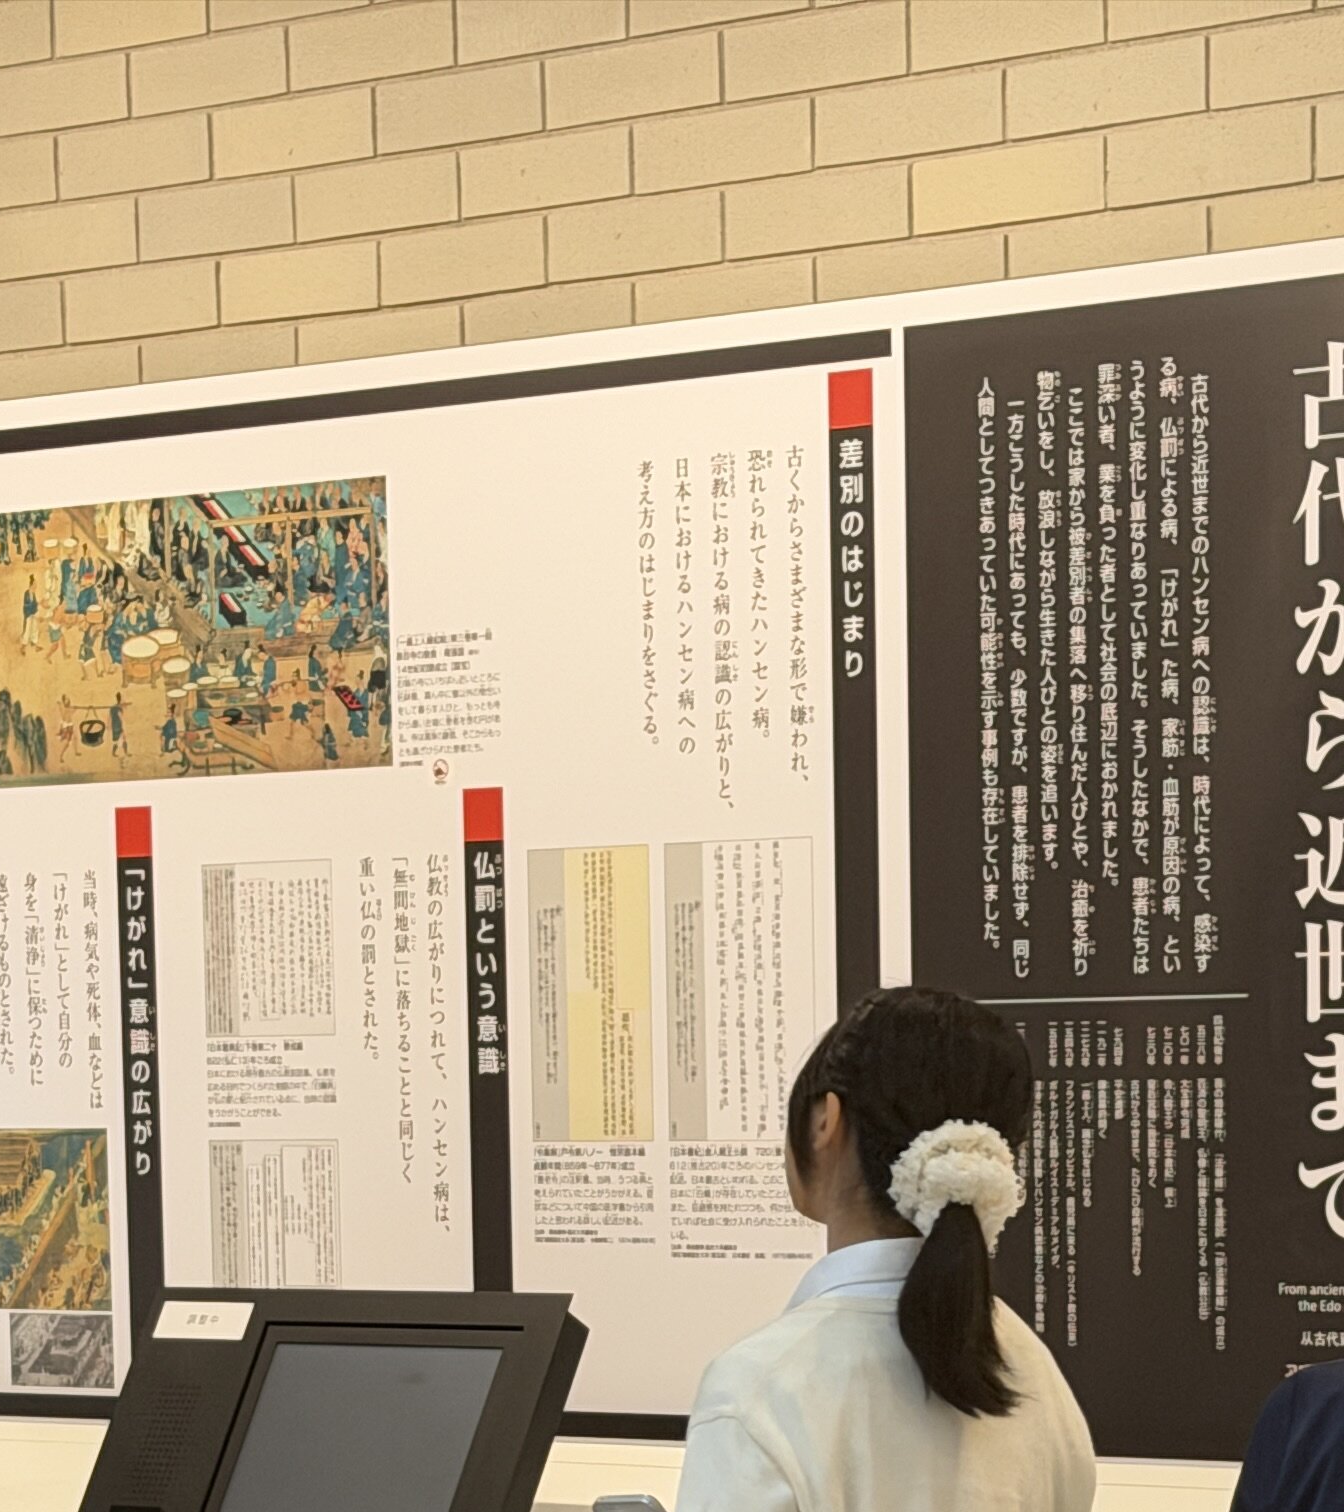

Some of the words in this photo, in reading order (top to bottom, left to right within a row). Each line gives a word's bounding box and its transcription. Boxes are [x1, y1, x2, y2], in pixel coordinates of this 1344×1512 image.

[637, 460, 660, 746] 考え方のはじまりをさぐる。
[674, 457, 697, 756] 日本におけるハンセン病への
[709, 452, 735, 809] 宗教における病の認識の広がりと、
[747, 448, 771, 739] 恐れられてきたハンセン病。
[785, 444, 810, 782] 古くからさまざまな形で嫌われ、
[839, 438, 865, 679] 差別のはじまり
[977, 377, 1001, 949] 人間としてつきあっていた可能性を示す事例も存在していました。
[1007, 401, 1031, 978] 一方こうした時代にあっても、少数ですが、患者を排除せず、同じ
[1036, 371, 1059, 870] 物乞いをし、放浪しながら生きた人びとの姿を追います。
[1129, 360, 1151, 975] うように変化し重なりあっていました。そうしたなかで、患者たちは
[1190, 372, 1213, 974] 古代から近世までのハンセン病への認識は、時代によって、感染す
[24, 871, 45, 1087] 身を「清浄」に保つために
[52, 872, 73, 1070] 「けがれ」として自分の
[82, 868, 104, 1110] 当時、病気や死体、血などは
[124, 867, 153, 1176] 「けがれ」意識の広がり
[359, 857, 380, 1061] 重い仏の罰とされた。
[392, 857, 415, 1186] 「無間地獄」に落ちることと同じく
[426, 853, 451, 1232] 仏教の広がりにつれて、ハンセン病は、
[473, 851, 501, 1075] 仏罰という意識
[1278, 1282, 1307, 1296] From
[1298, 1299, 1317, 1312] the
[1319, 1300, 1342, 1313] Edo
